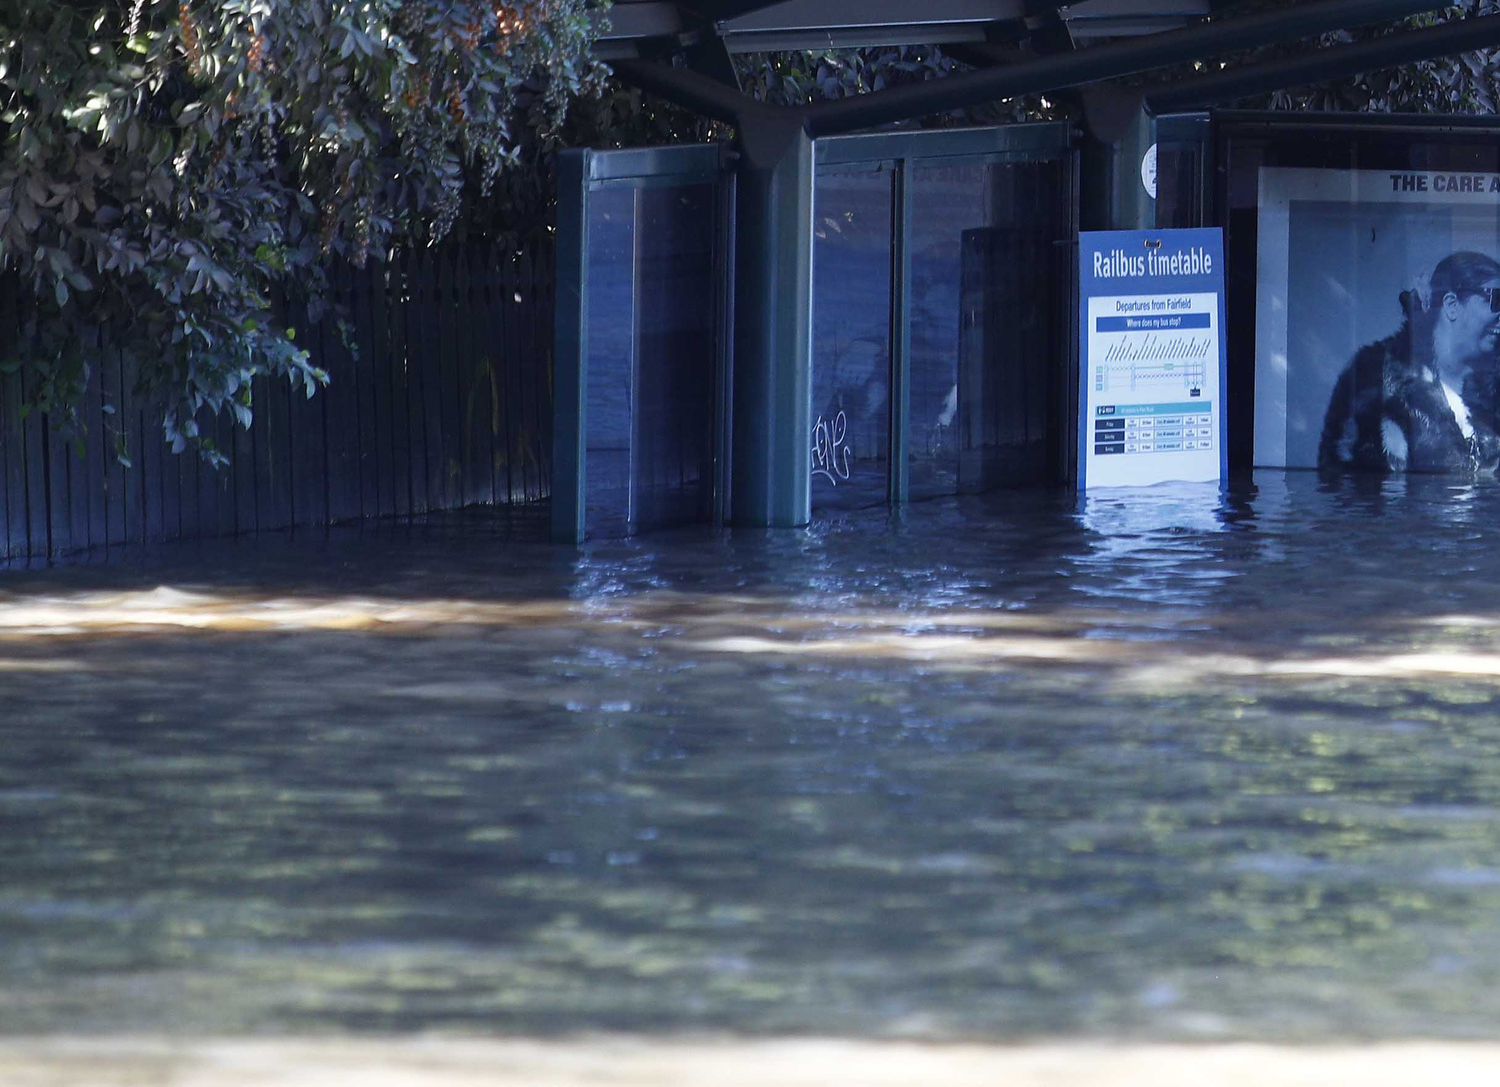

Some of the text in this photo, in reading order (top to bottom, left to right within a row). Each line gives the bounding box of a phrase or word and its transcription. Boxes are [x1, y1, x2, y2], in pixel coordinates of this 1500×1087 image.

[1390, 175, 1428, 192] THE
[1433, 175, 1485, 192] CARE
[1093, 247, 1212, 278] Railbus timetable
[1116, 298, 1191, 313] Departures from Fairfield
[1126, 317, 1181, 328] Where does my bus stop?
